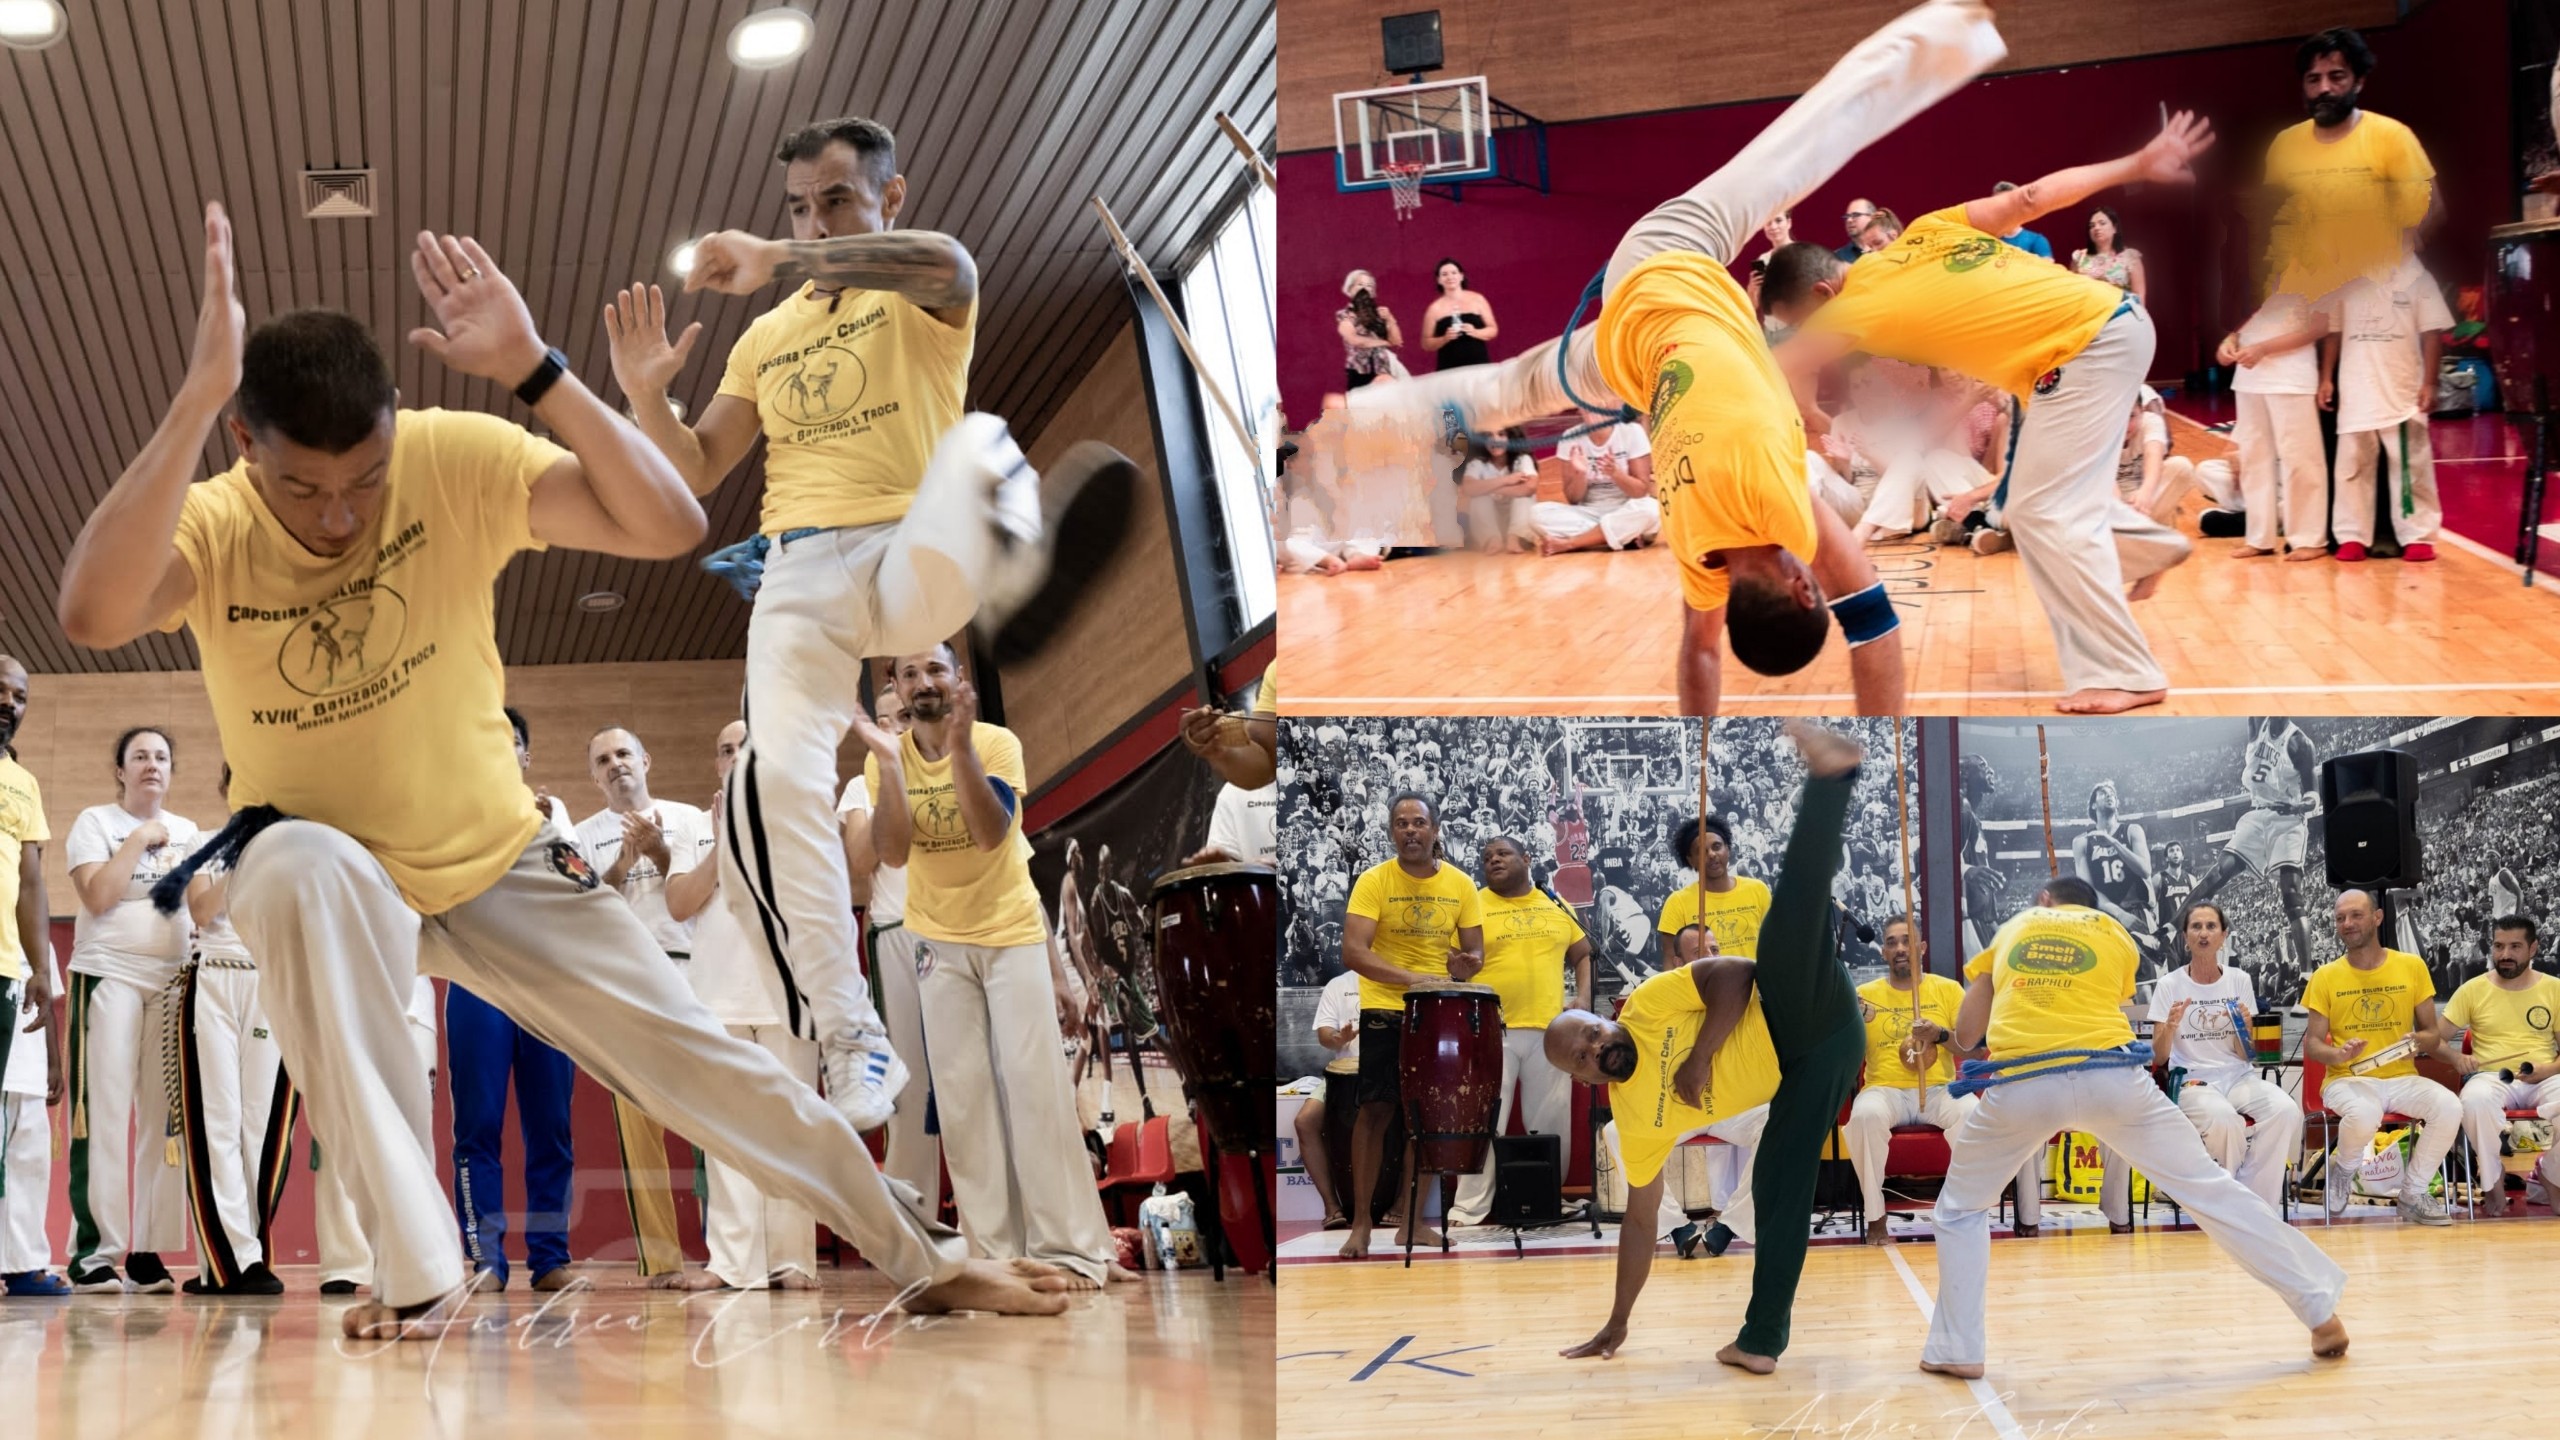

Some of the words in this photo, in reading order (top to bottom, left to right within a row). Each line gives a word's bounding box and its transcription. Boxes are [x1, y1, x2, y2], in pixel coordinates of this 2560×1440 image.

[378, 519, 425, 563] agliari
[313, 677, 388, 717] Batizado
[2473, 748, 2502, 763] COVIDIEN
[2251, 763, 2271, 783] 5
[1570, 843, 1588, 861] 23
[1607, 857, 1623, 868] NBA
[2102, 860, 2125, 884] 16
[2029, 942, 2076, 955] Smell
[2026, 951, 2075, 964] Brasil
[2364, 1165, 2395, 1176] natura
[1287, 1176, 1315, 1186] BAS
